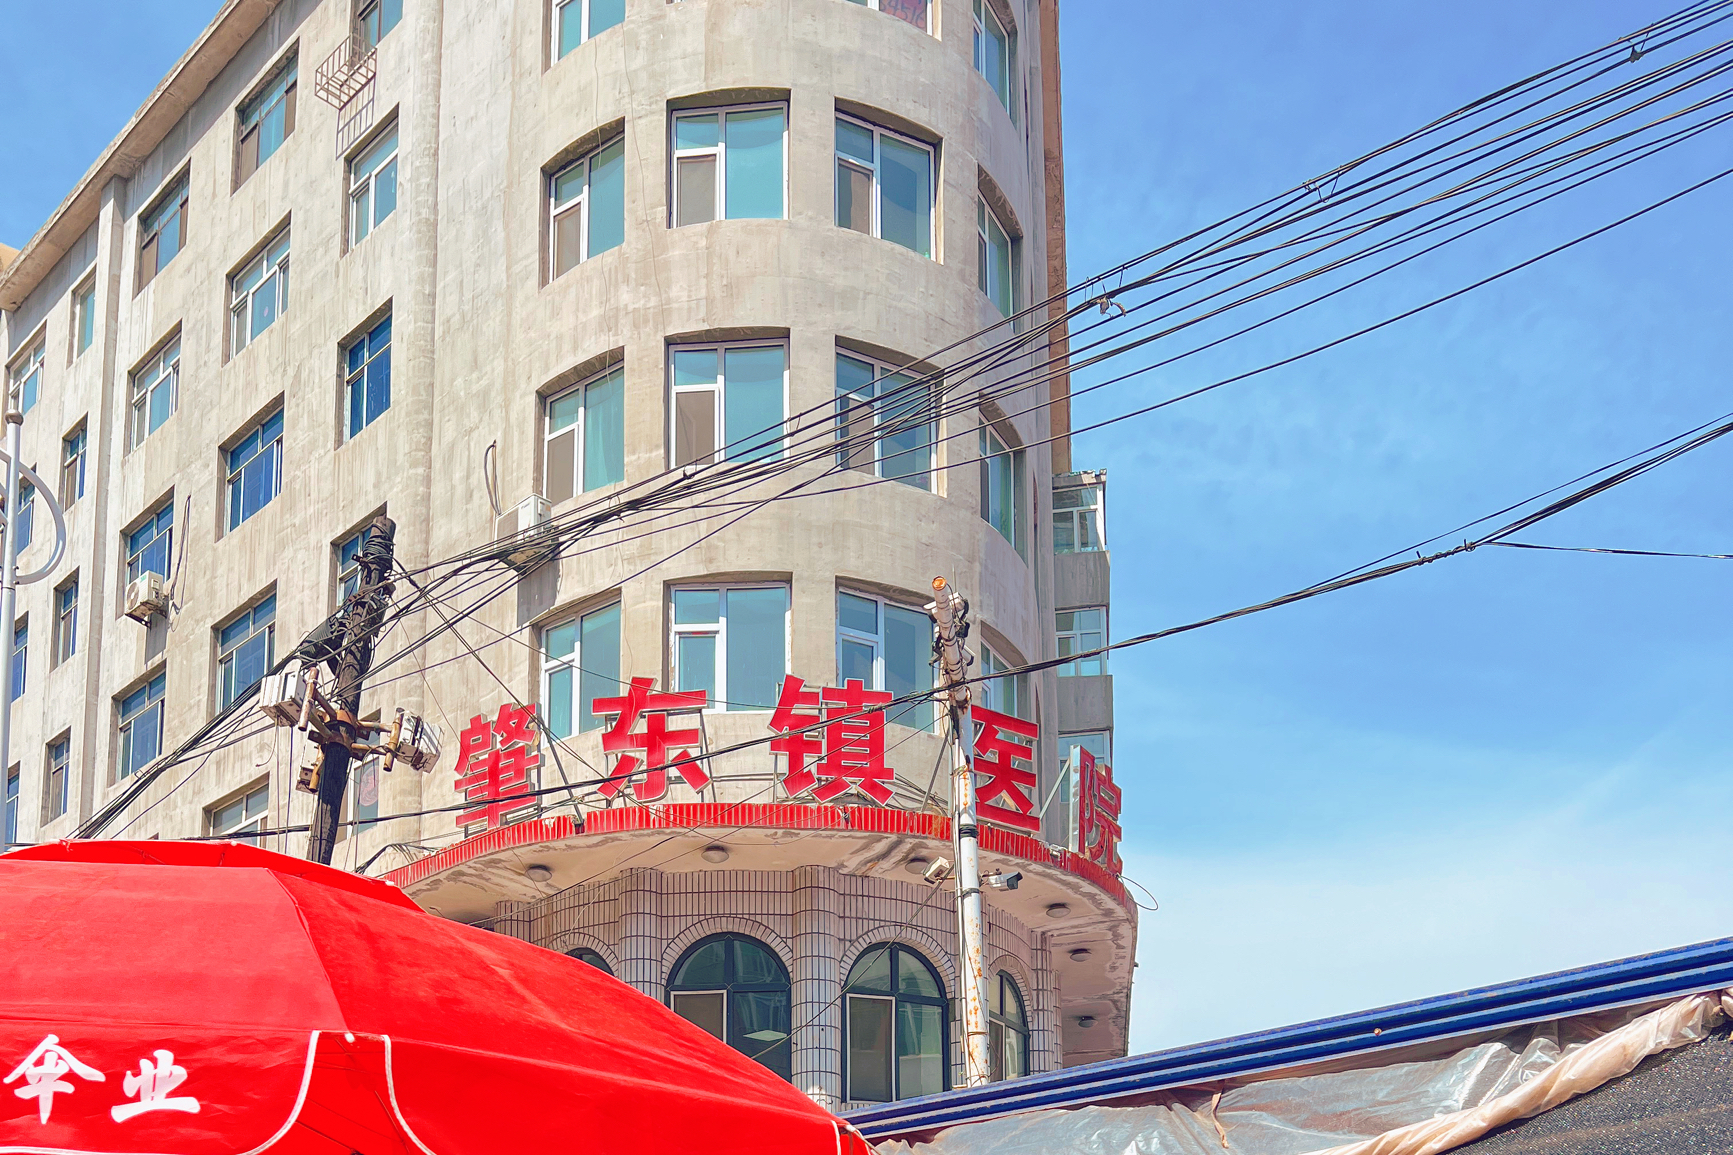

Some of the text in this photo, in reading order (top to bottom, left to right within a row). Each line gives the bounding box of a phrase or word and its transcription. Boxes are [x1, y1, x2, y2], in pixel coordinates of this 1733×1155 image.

[454, 675, 1122, 877] 肇东镇医院
[3, 1034, 200, 1124] 伞业
